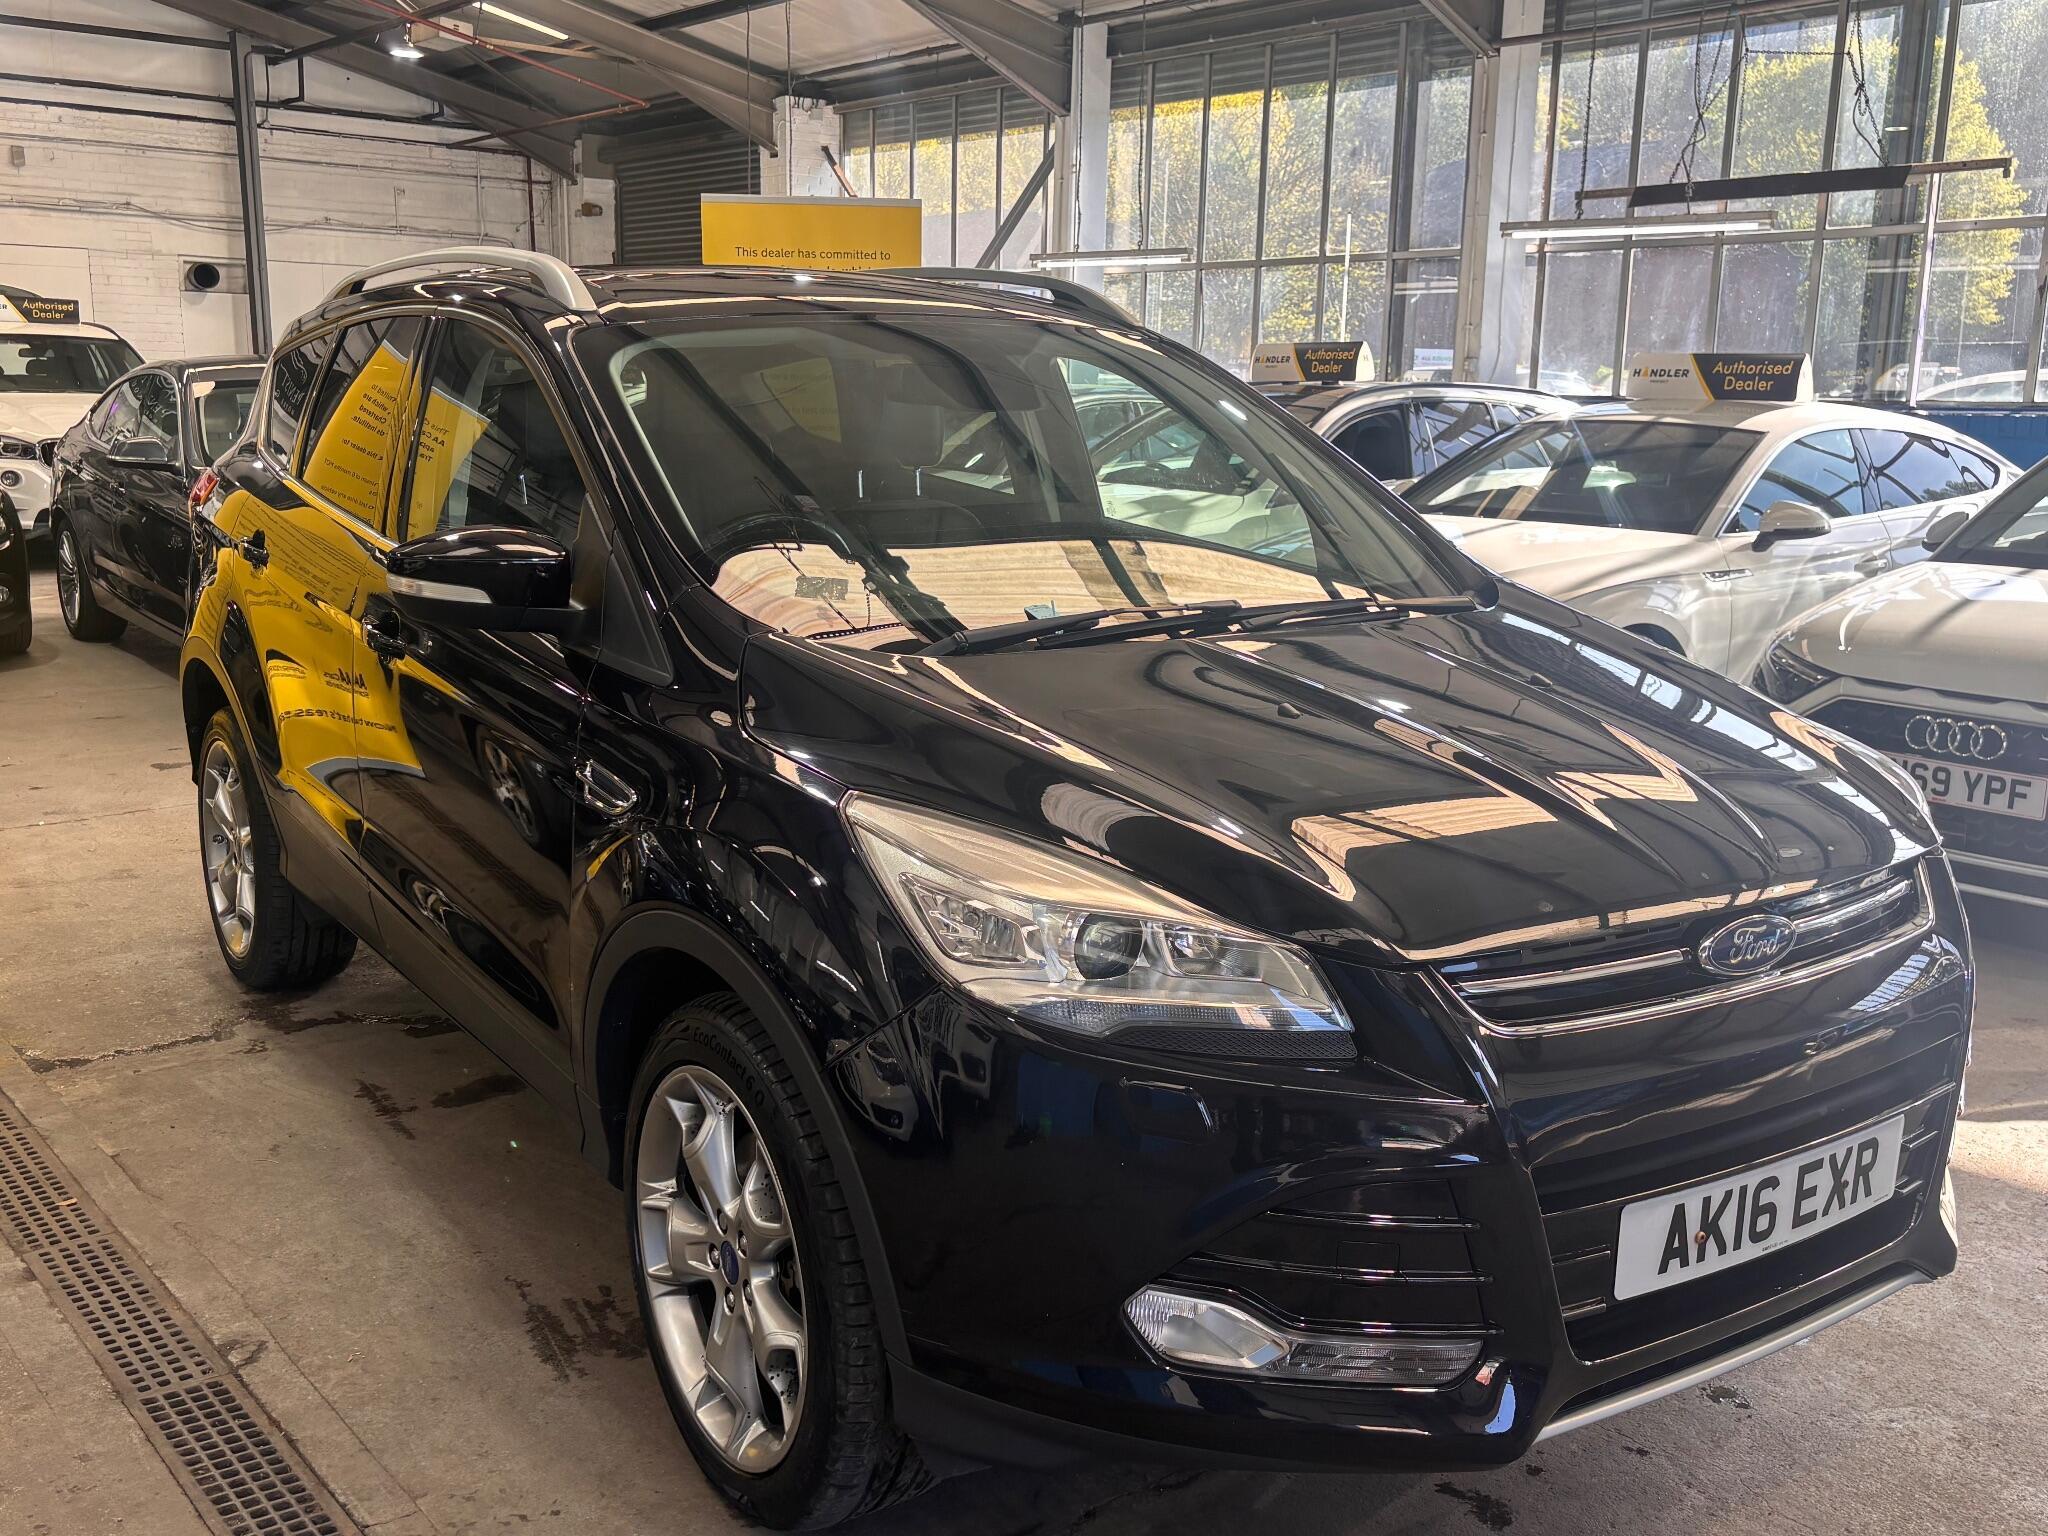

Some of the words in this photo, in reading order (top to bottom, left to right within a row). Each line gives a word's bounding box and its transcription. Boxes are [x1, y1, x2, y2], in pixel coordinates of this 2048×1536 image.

[735, 246, 758, 257] This
[761, 247, 795, 258] dealer
[798, 248, 817, 259] has
[819, 248, 877, 260] committed
[880, 249, 891, 260] to
[22, 299, 74, 311] Authorised
[32, 309, 65, 319] Dealer
[1304, 347, 1356, 360] Authorised
[1311, 361, 1343, 374] Dealer
[1712, 360, 1795, 375] Authorised
[1724, 376, 1774, 391] Dealer
[1963, 769, 2032, 810] YPF
[1729, 924, 1781, 964] Ford
[693, 1026, 746, 1080] EcoContact
[1657, 1175, 1781, 1275] AK16
[1791, 1136, 1880, 1230] EXR
